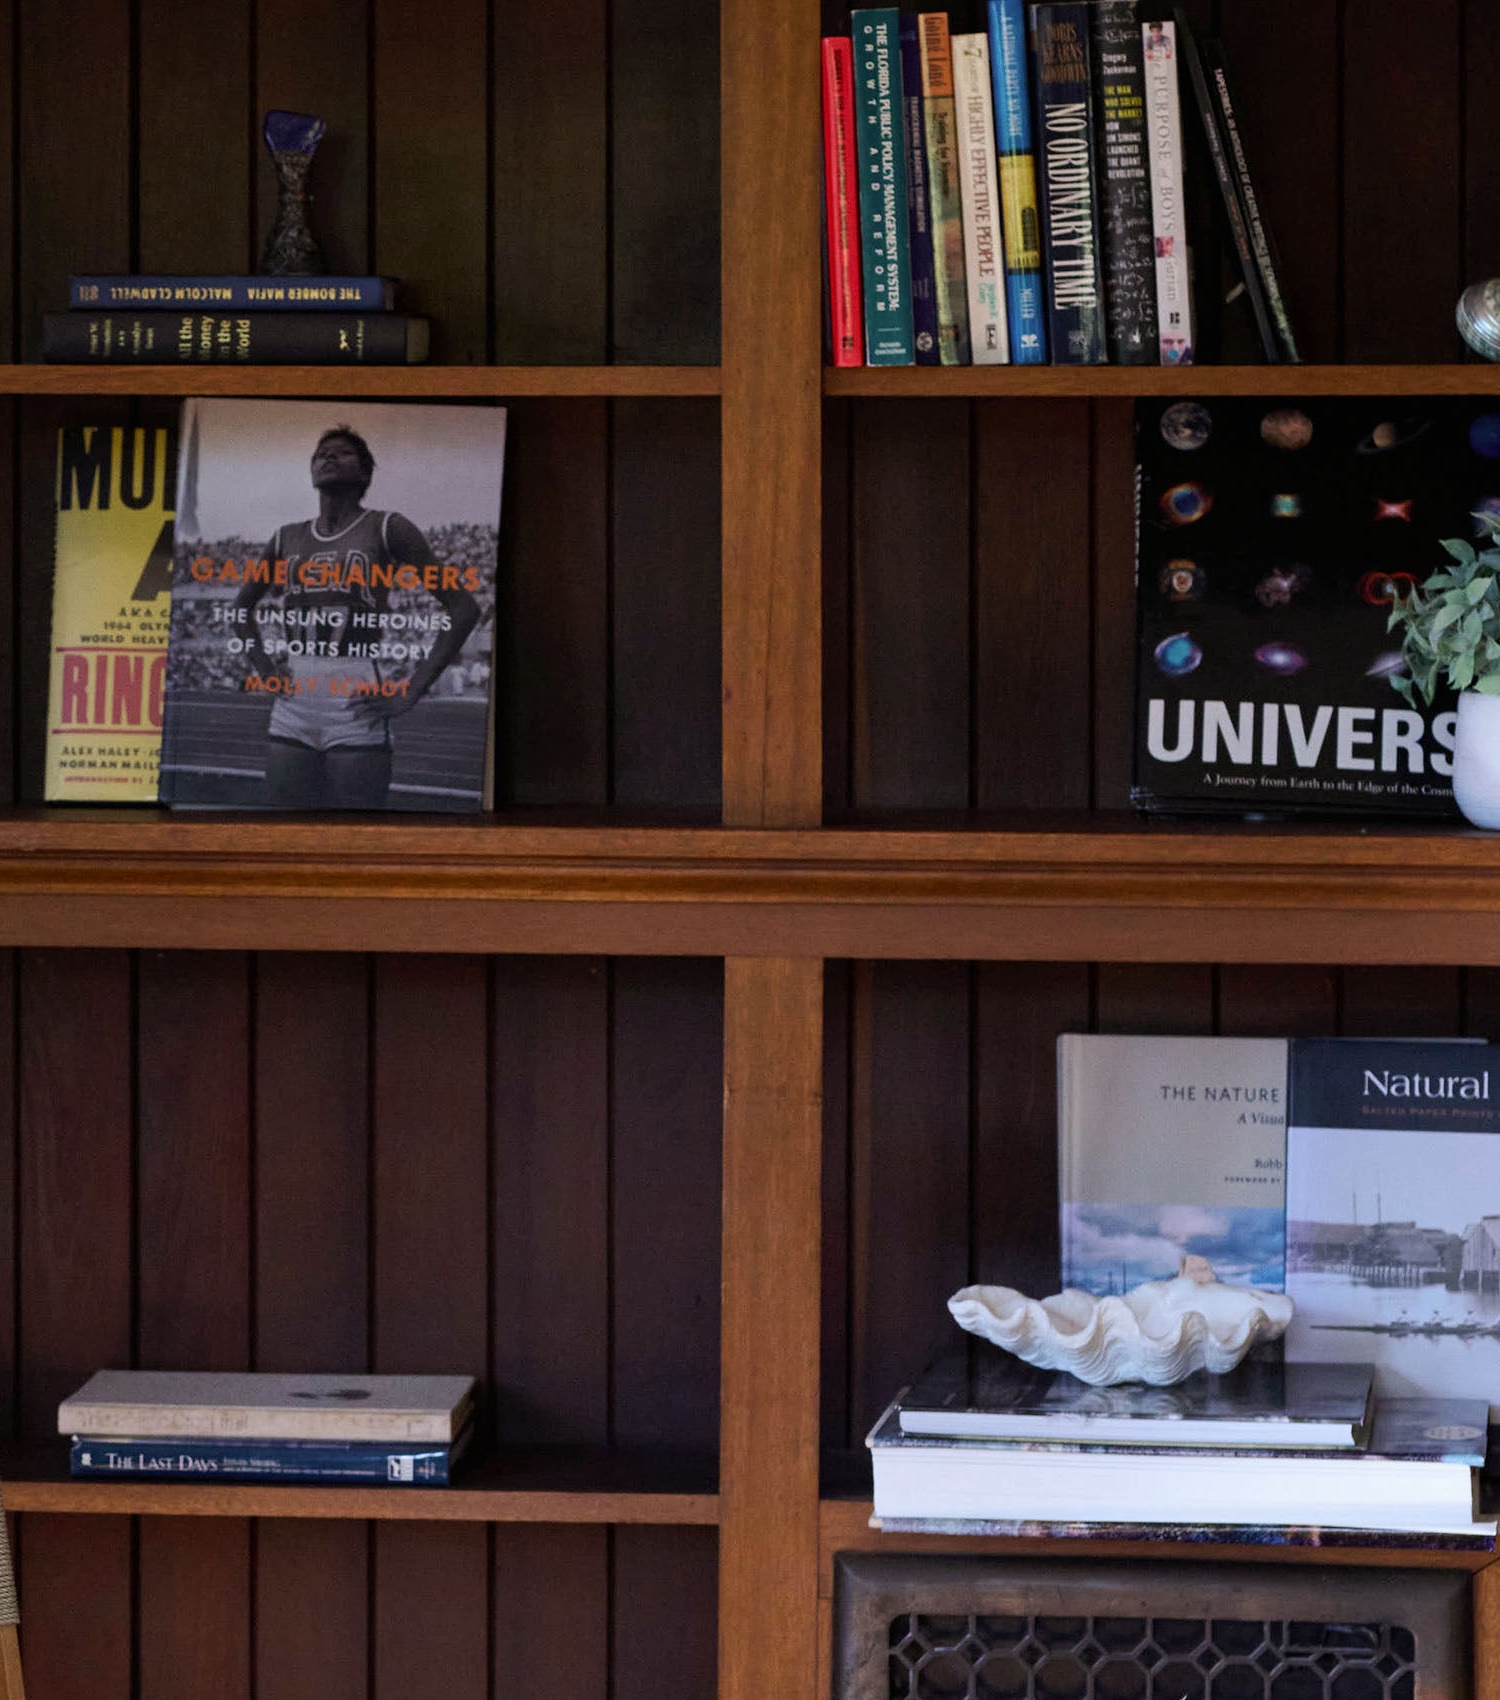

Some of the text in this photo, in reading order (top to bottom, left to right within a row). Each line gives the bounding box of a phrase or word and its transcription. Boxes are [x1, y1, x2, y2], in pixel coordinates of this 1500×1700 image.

[876, 23, 888, 46] THE
[964, 48, 983, 58] 7
[877, 48, 890, 97] FLORIDA
[880, 99, 892, 139] PUBLIC
[968, 96, 985, 144] HIGHLY
[1154, 75, 1173, 162] PURPOSE
[870, 147, 881, 191] AND
[881, 142, 894, 183] POLICY
[971, 150, 991, 222] EFFECTIVE
[1044, 103, 1097, 311] NO ORDINARY TIME
[1160, 186, 1176, 239] BOYS
[883, 184, 898, 261] MANAGEMENT
[976, 226, 995, 277] PEOPLE
[110, 286, 171, 301] GLADWELL
[175, 286, 233, 301] MALCOLM
[247, 287, 362, 301] THE BOMBER MAFIA
[1021, 288, 1035, 319] MILLER
[178, 316, 194, 340] the
[216, 318, 232, 344] the
[190, 556, 480, 592] GAME CHANGERS
[212, 606, 452, 631] THE UNSUNG HEROINES
[80, 634, 167, 645] WORLD HEAV
[226, 638, 434, 660] OF SPORTS HISTORY
[243, 675, 318, 695] MOLLY
[1147, 698, 1457, 777] UNIVERS
[1203, 773, 1213, 784] A
[1214, 773, 1258, 789] Journey
[1260, 775, 1288, 789] from
[1290, 777, 1321, 790] Earth
[1323, 779, 1335, 790] to
[1337, 779, 1355, 791] the
[1358, 780, 1385, 796] Edge
[1387, 781, 1399, 794] of
[1402, 782, 1419, 795] the
[1160, 1085, 1280, 1103] THE NATURE
[1362, 1069, 1490, 1100] Natural
[1237, 1112, 1247, 1125] A
[104, 1452, 137, 1470] THE
[138, 1452, 174, 1471] LAST
[179, 1454, 219, 1473] DAYS
